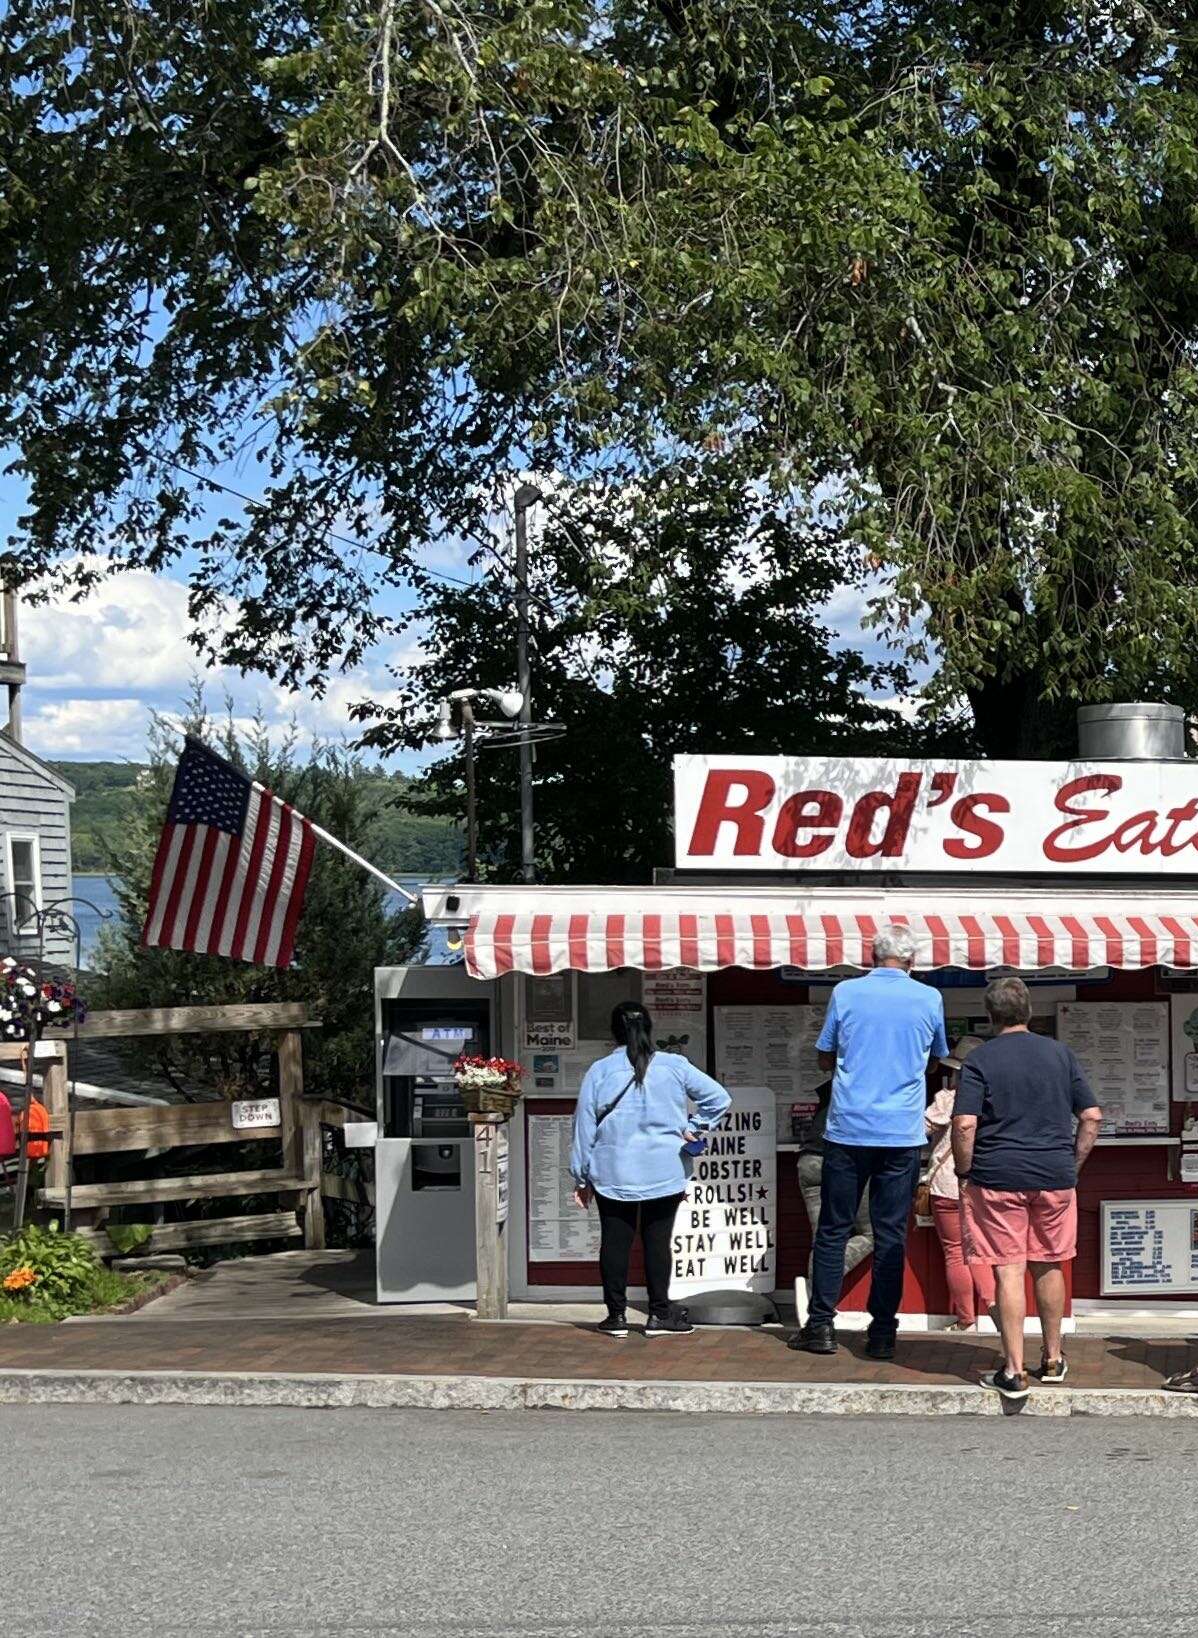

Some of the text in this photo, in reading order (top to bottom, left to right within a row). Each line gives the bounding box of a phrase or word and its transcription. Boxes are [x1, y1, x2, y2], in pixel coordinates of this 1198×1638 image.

[687, 769, 1010, 860] Red's
[432, 1027, 465, 1039] ATM
[527, 1022, 570, 1033] Best of
[527, 1034, 572, 1046] Maine
[240, 1113, 273, 1121] DOWN
[242, 1104, 268, 1113] STEP
[703, 1136, 746, 1156] AINE
[691, 1159, 762, 1181] OBSTER
[694, 1183, 753, 1205] ROLLS!
[691, 1206, 769, 1228] BE WELL
[673, 1230, 775, 1254] STAY WELL
[675, 1255, 769, 1278] EAT WELL
